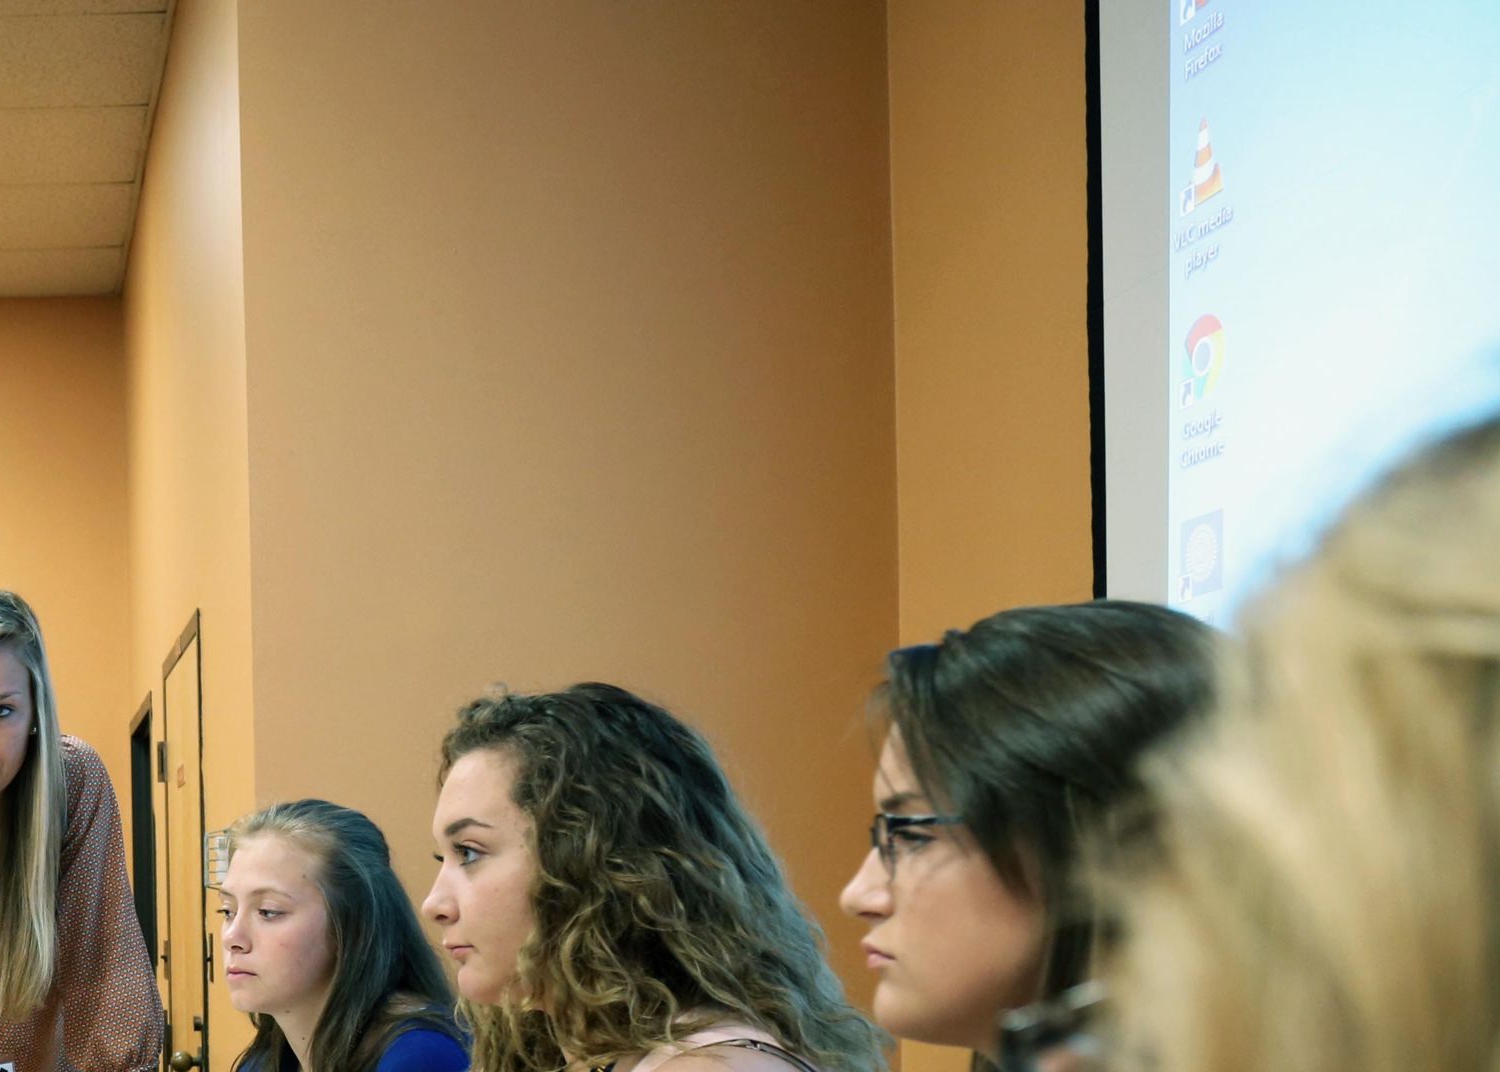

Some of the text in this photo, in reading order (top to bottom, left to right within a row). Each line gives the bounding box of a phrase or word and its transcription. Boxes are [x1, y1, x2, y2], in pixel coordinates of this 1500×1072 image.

[1184, 11, 1224, 52] Mozilla
[1184, 44, 1223, 80] Firefox
[1173, 206, 1233, 252] VLC media
[1183, 241, 1220, 280] player
[1182, 409, 1222, 439] Google
[1180, 441, 1226, 469] Chrome
